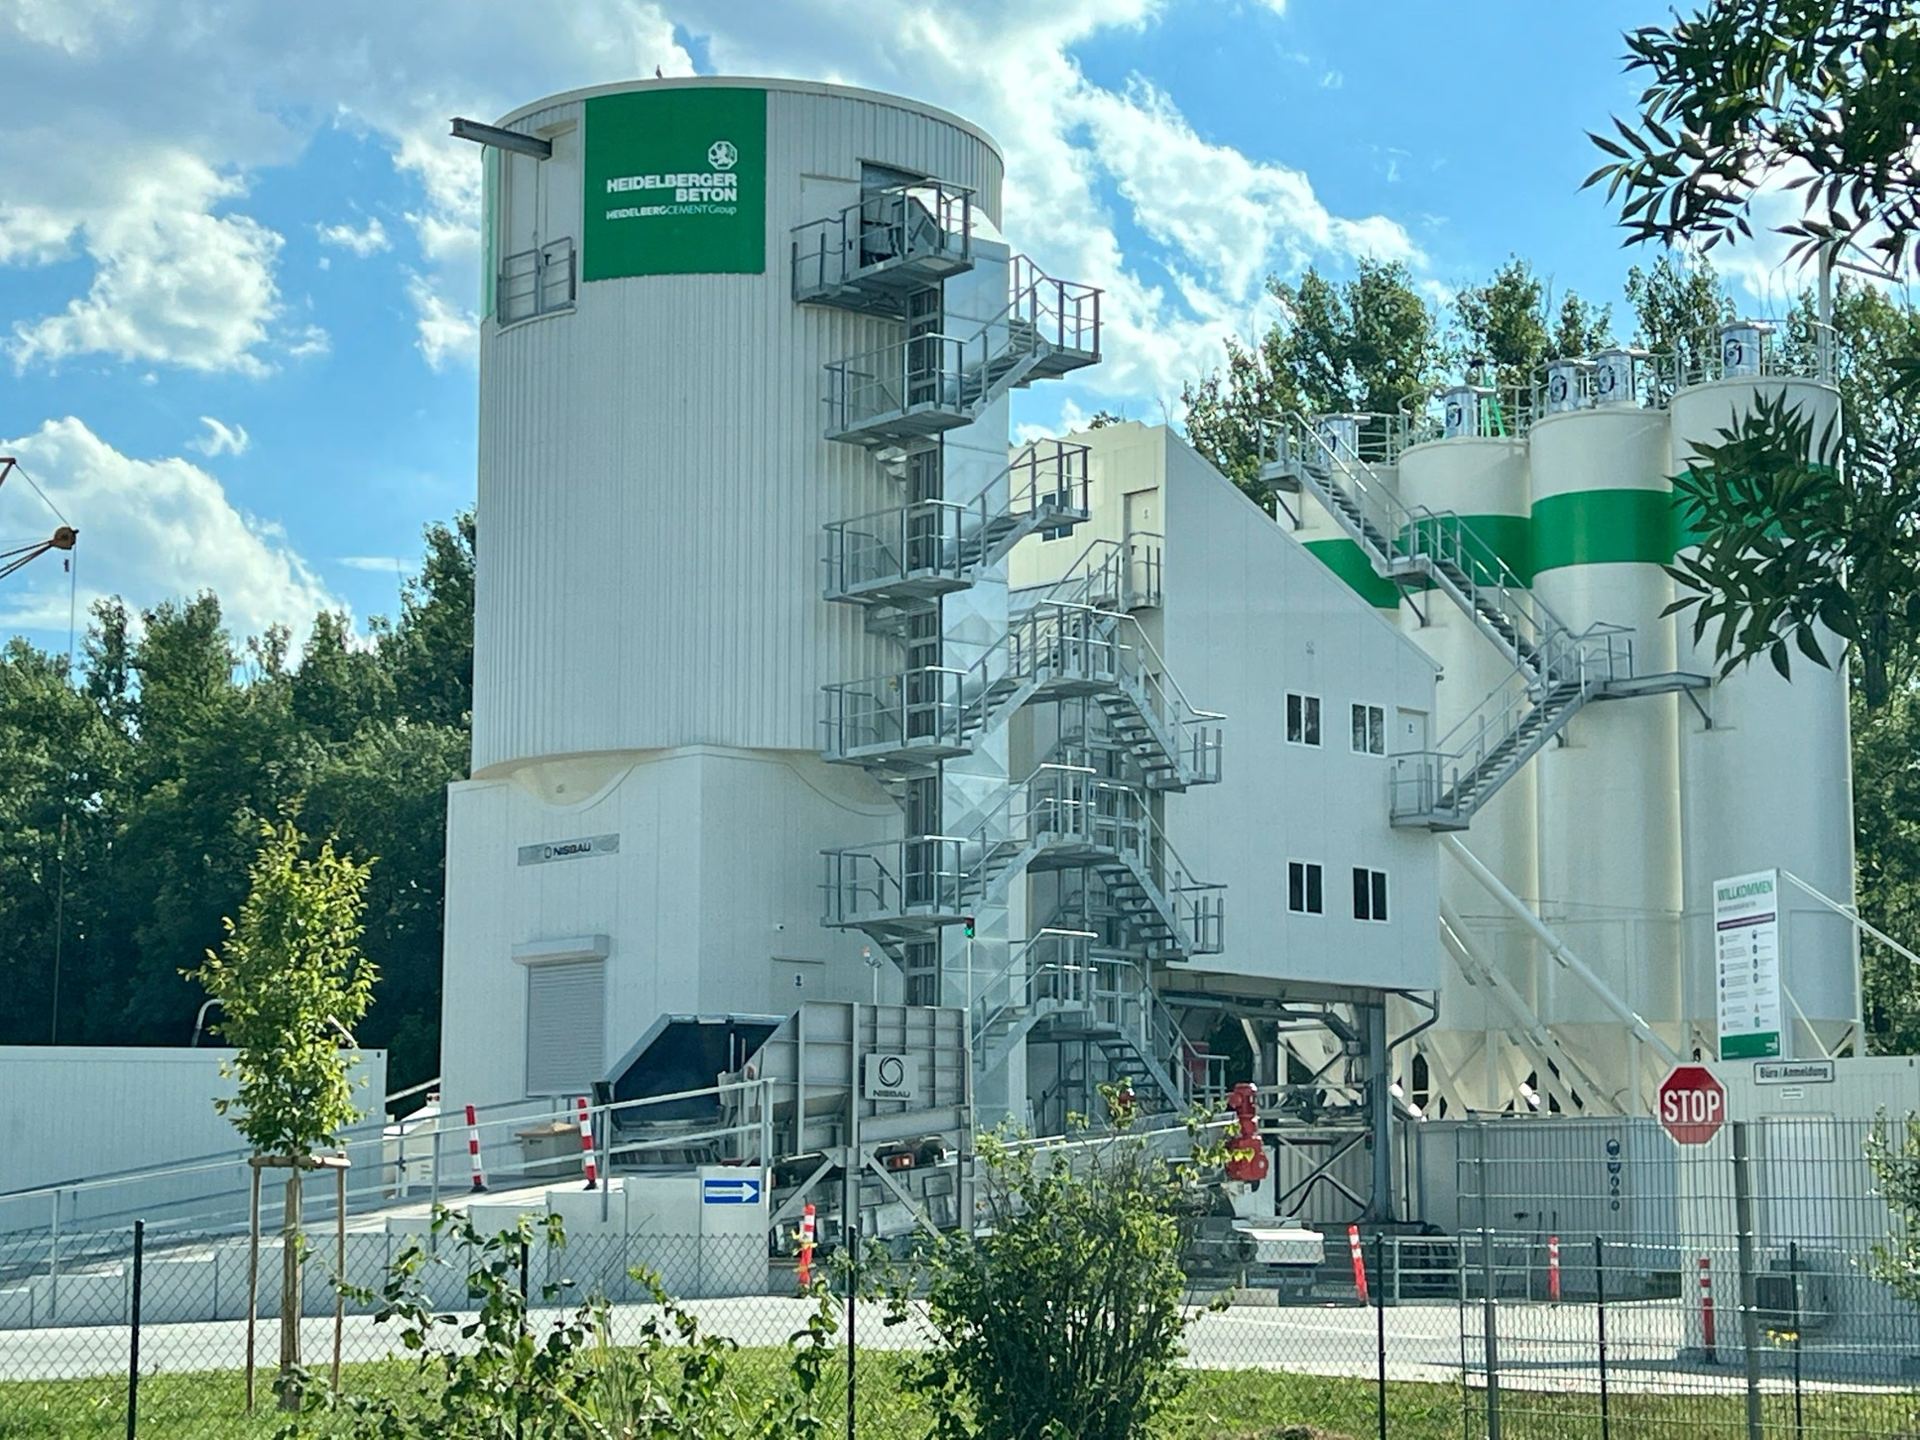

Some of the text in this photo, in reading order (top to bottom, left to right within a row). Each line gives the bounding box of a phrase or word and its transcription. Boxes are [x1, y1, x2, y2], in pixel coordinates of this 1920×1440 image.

[607, 173, 737, 193] HEIDELBERGER
[675, 188, 738, 202] BETON
[606, 204, 737, 219] HEIDELBERGCEMENT Group
[1717, 880, 1773, 900] WILLKOMMEN
[1783, 1065, 1828, 1079] Anmeldung
[1664, 1089, 1720, 1122] STOP
